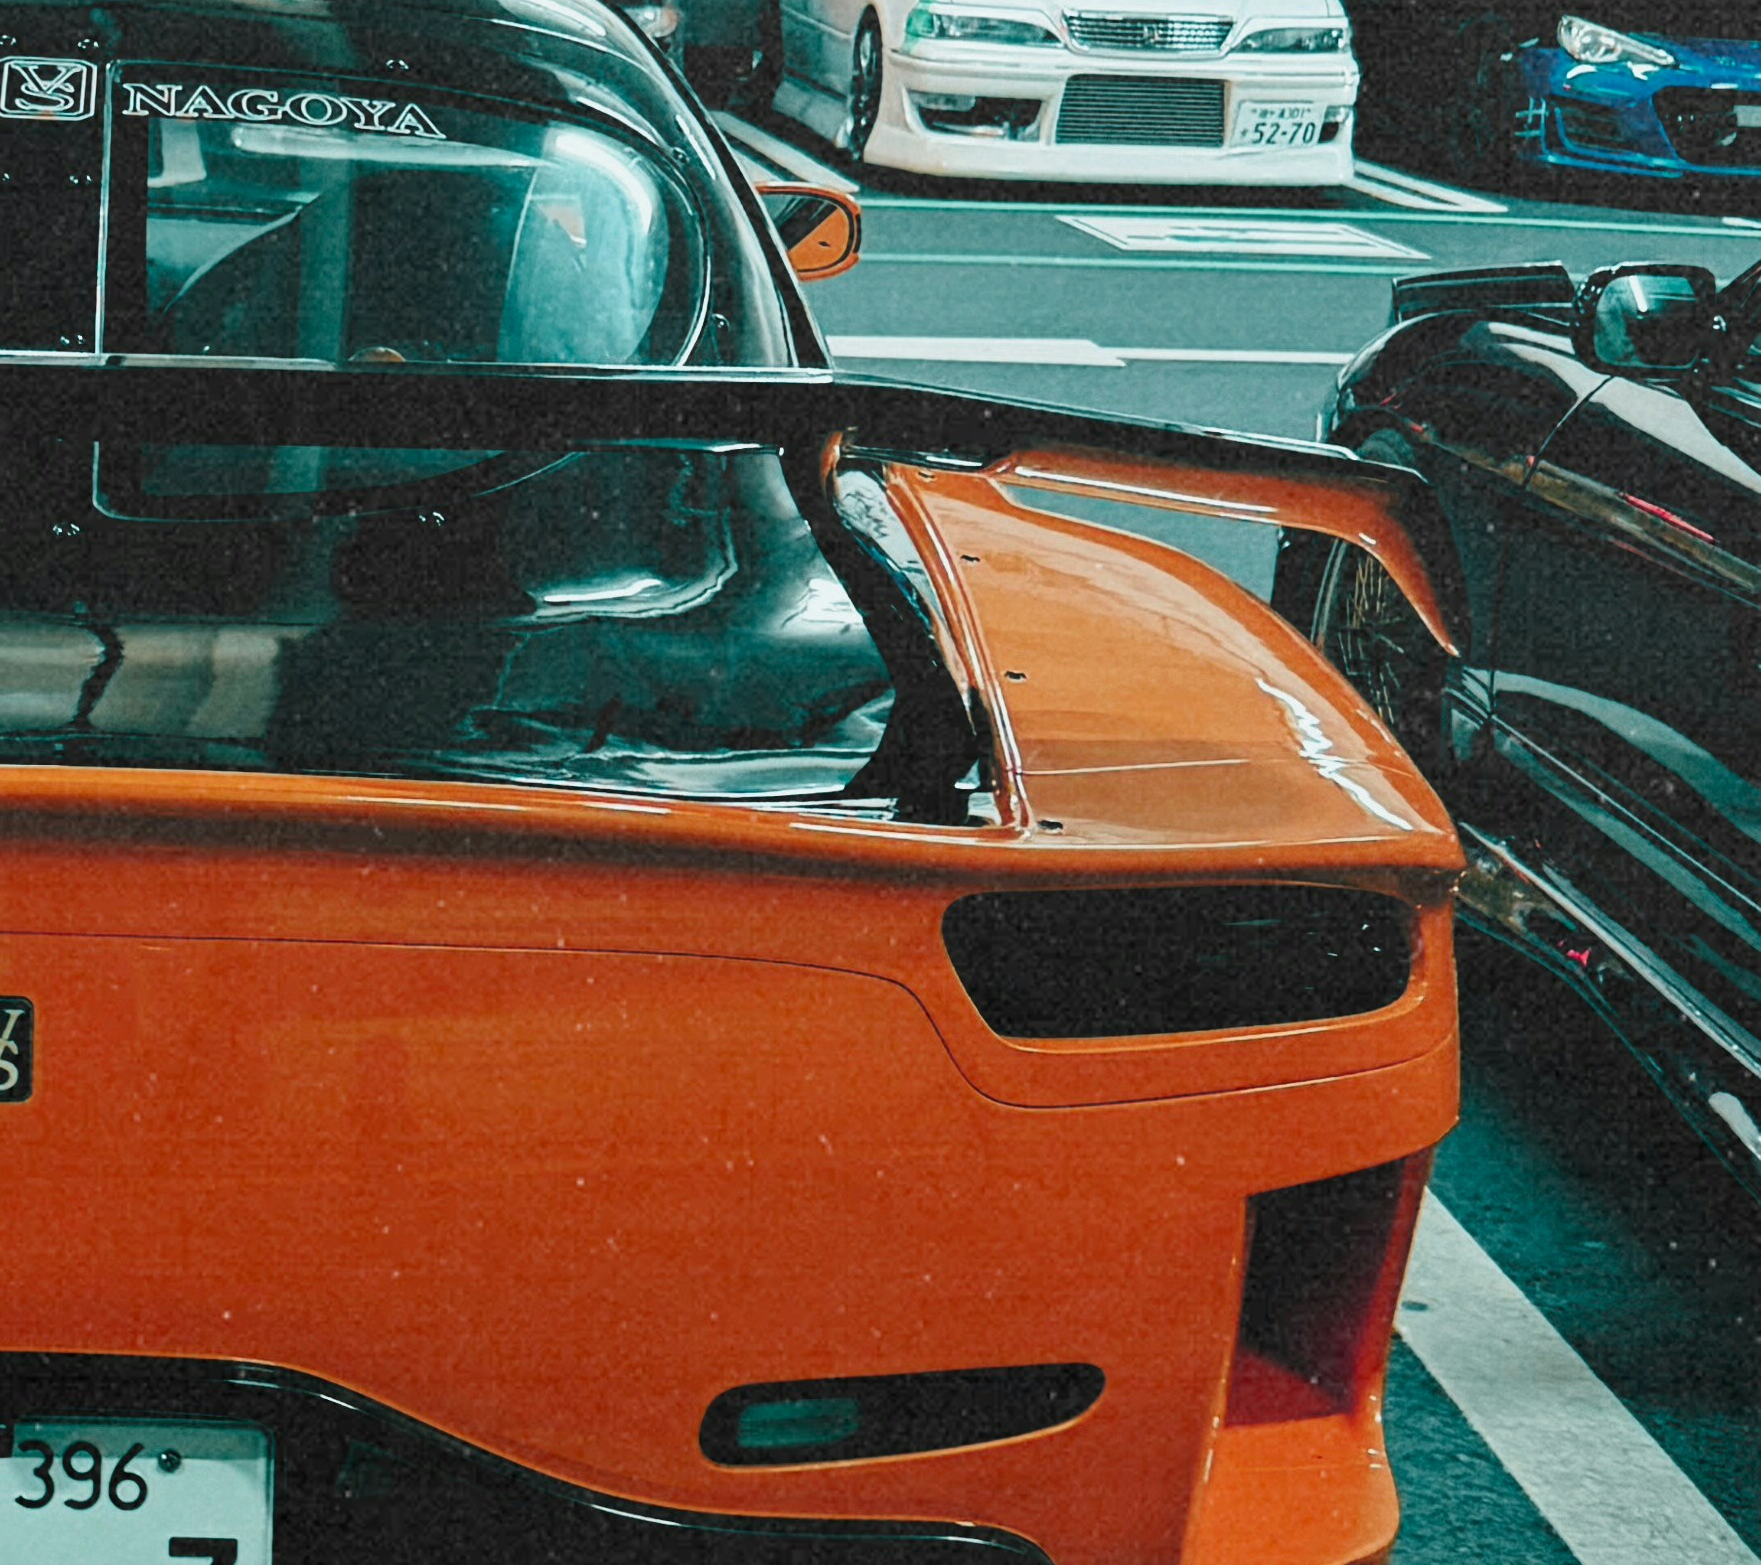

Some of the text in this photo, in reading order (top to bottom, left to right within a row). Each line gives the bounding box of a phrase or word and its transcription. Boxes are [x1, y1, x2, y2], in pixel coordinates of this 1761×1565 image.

[122, 83, 447, 140] NAGOYA
[1251, 121, 1316, 145] 52-70
[14, 1439, 150, 1512] 396
